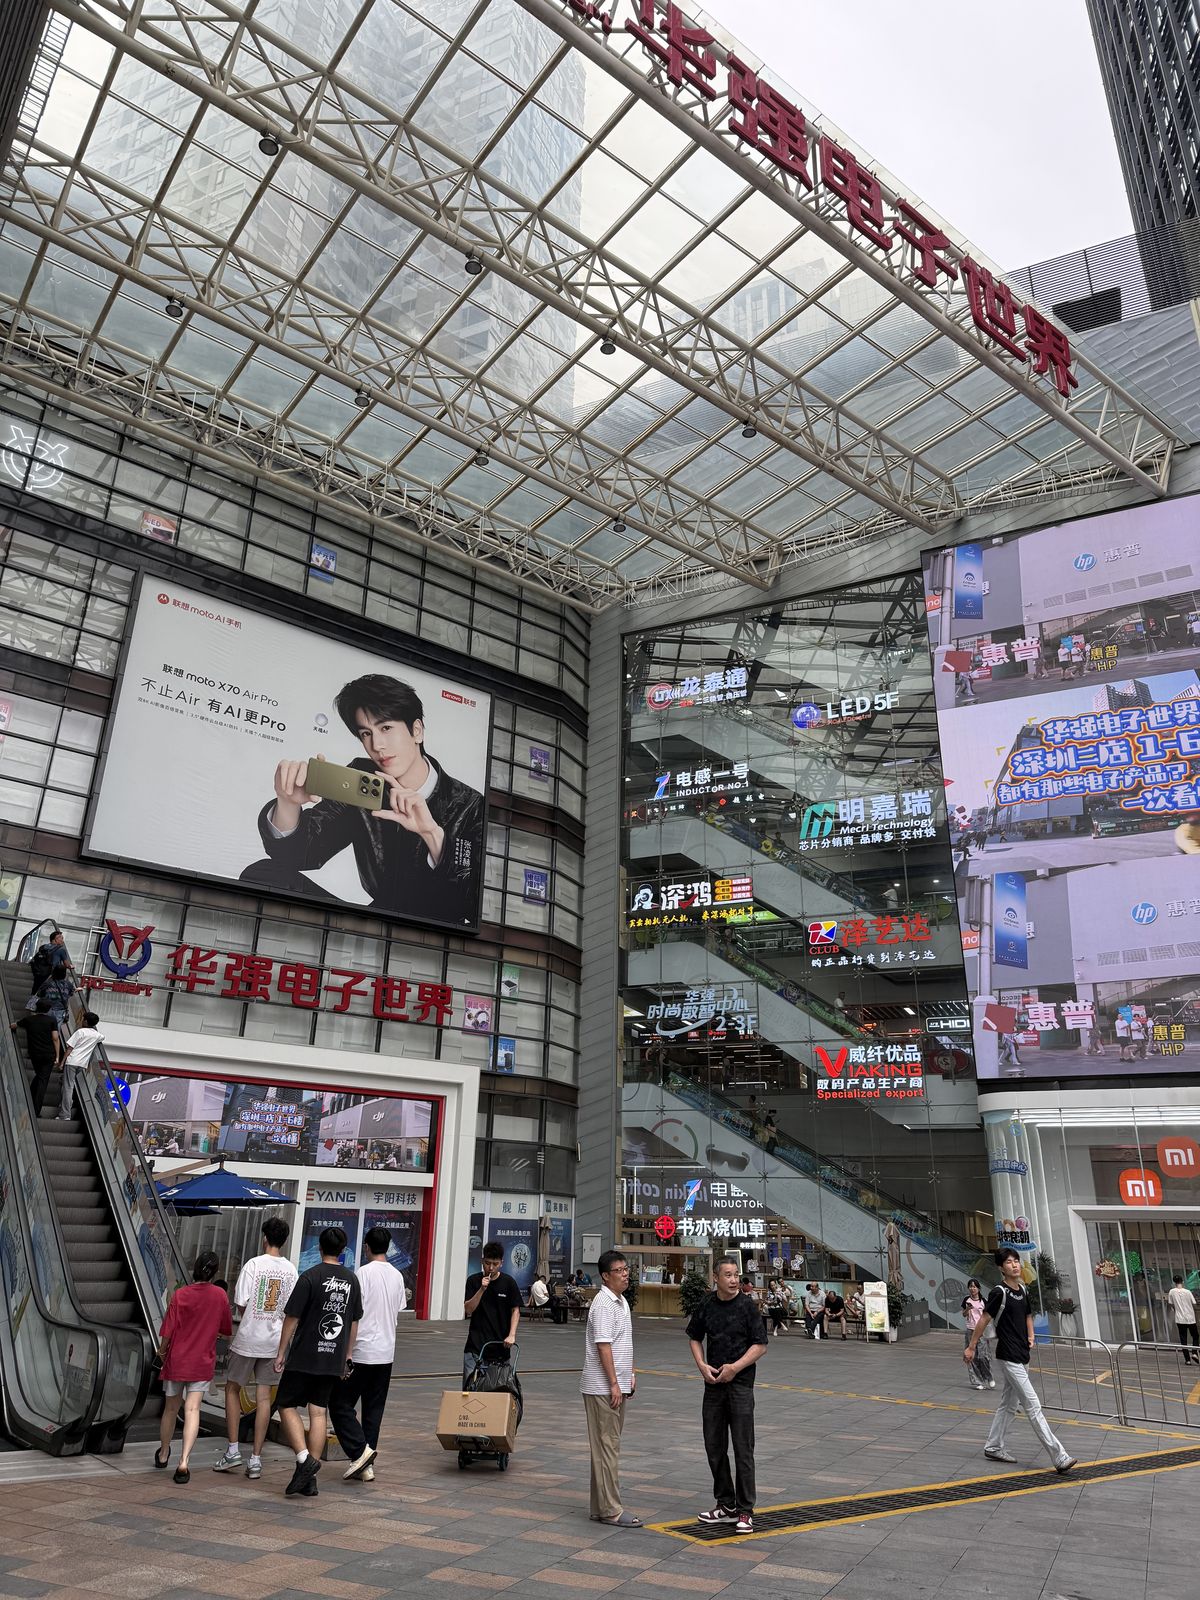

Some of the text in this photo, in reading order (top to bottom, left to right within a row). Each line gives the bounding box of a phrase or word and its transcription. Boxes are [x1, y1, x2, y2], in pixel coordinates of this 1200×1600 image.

[624, 0, 1079, 397] 华强电子世界
[981, 636, 1042, 667] 惠普
[1089, 643, 1120, 661] 惠普
[1097, 659, 1118, 672] HP
[162, 663, 279, 708] 联想 moto X70 Air Pro
[681, 667, 747, 697] 龙泰通
[826, 697, 871, 719] LED
[1042, 700, 1200, 743] 华强电子世界
[676, 764, 749, 788] 电感一号
[676, 784, 725, 797] INDUCTOR
[838, 790, 932, 824] 明嘉瑞
[872, 817, 934, 832] Technology
[799, 827, 936, 850] 芯片分销商 品牌多 交付快
[661, 881, 711, 911] 深鸿
[839, 912, 933, 948] 泽艺达
[809, 945, 840, 956] CLUB
[165, 943, 454, 1026] 华强电子世界
[716, 1014, 757, 1032] 2-3F
[1025, 1000, 1097, 1031] 惠普
[1152, 1023, 1186, 1041] 惠普
[849, 1044, 922, 1063] 威纤优品
[1161, 1043, 1185, 1056] HP
[817, 1077, 923, 1090] 数码产品生产商
[817, 1088, 924, 1100] Specialized export
[306, 1188, 356, 1203] EYANG
[373, 1191, 417, 1206] 宇阳科技
[677, 1217, 765, 1238] 书亦烧仙草
